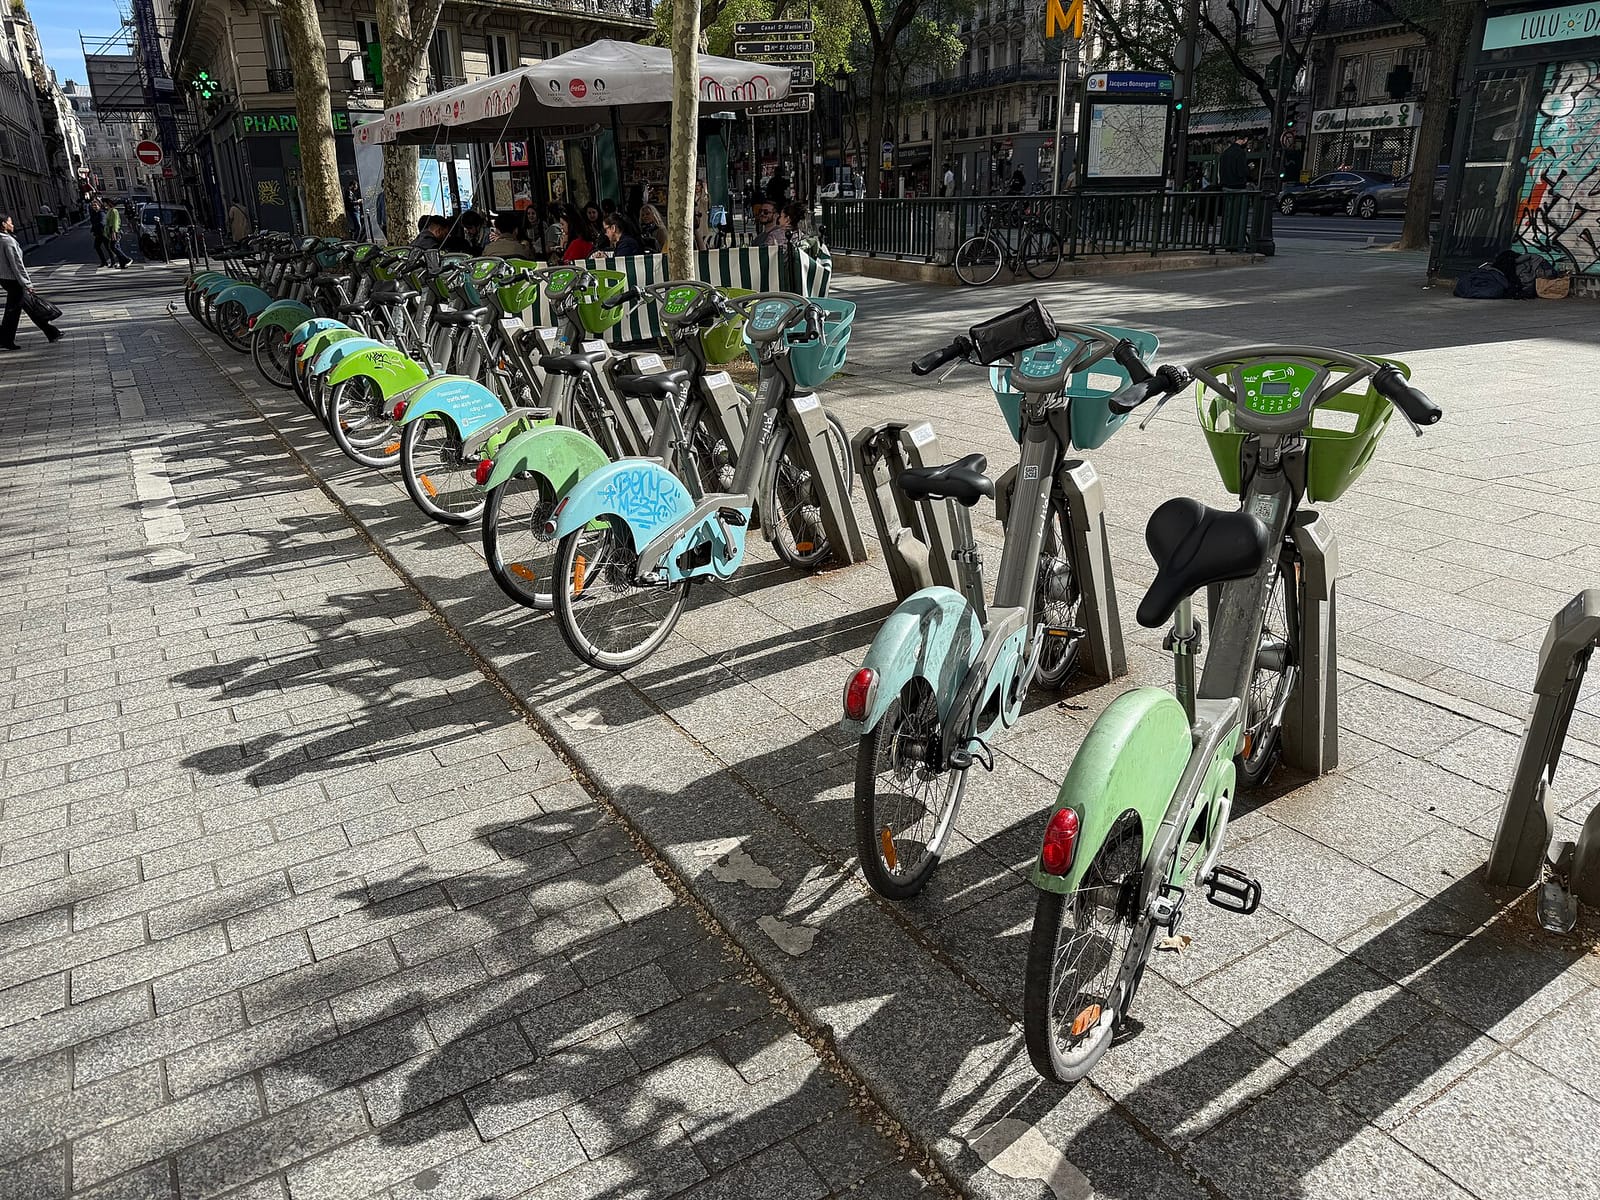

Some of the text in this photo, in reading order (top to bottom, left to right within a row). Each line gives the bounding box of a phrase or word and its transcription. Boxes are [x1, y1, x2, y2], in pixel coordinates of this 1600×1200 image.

[1045, 0, 1084, 39] M
[1520, 13, 1560, 40] LULU
[1108, 80, 1157, 89] Jacques Bonsergent
[243, 113, 348, 132] PHARIE
[1313, 110, 1394, 131] Pharmacie
